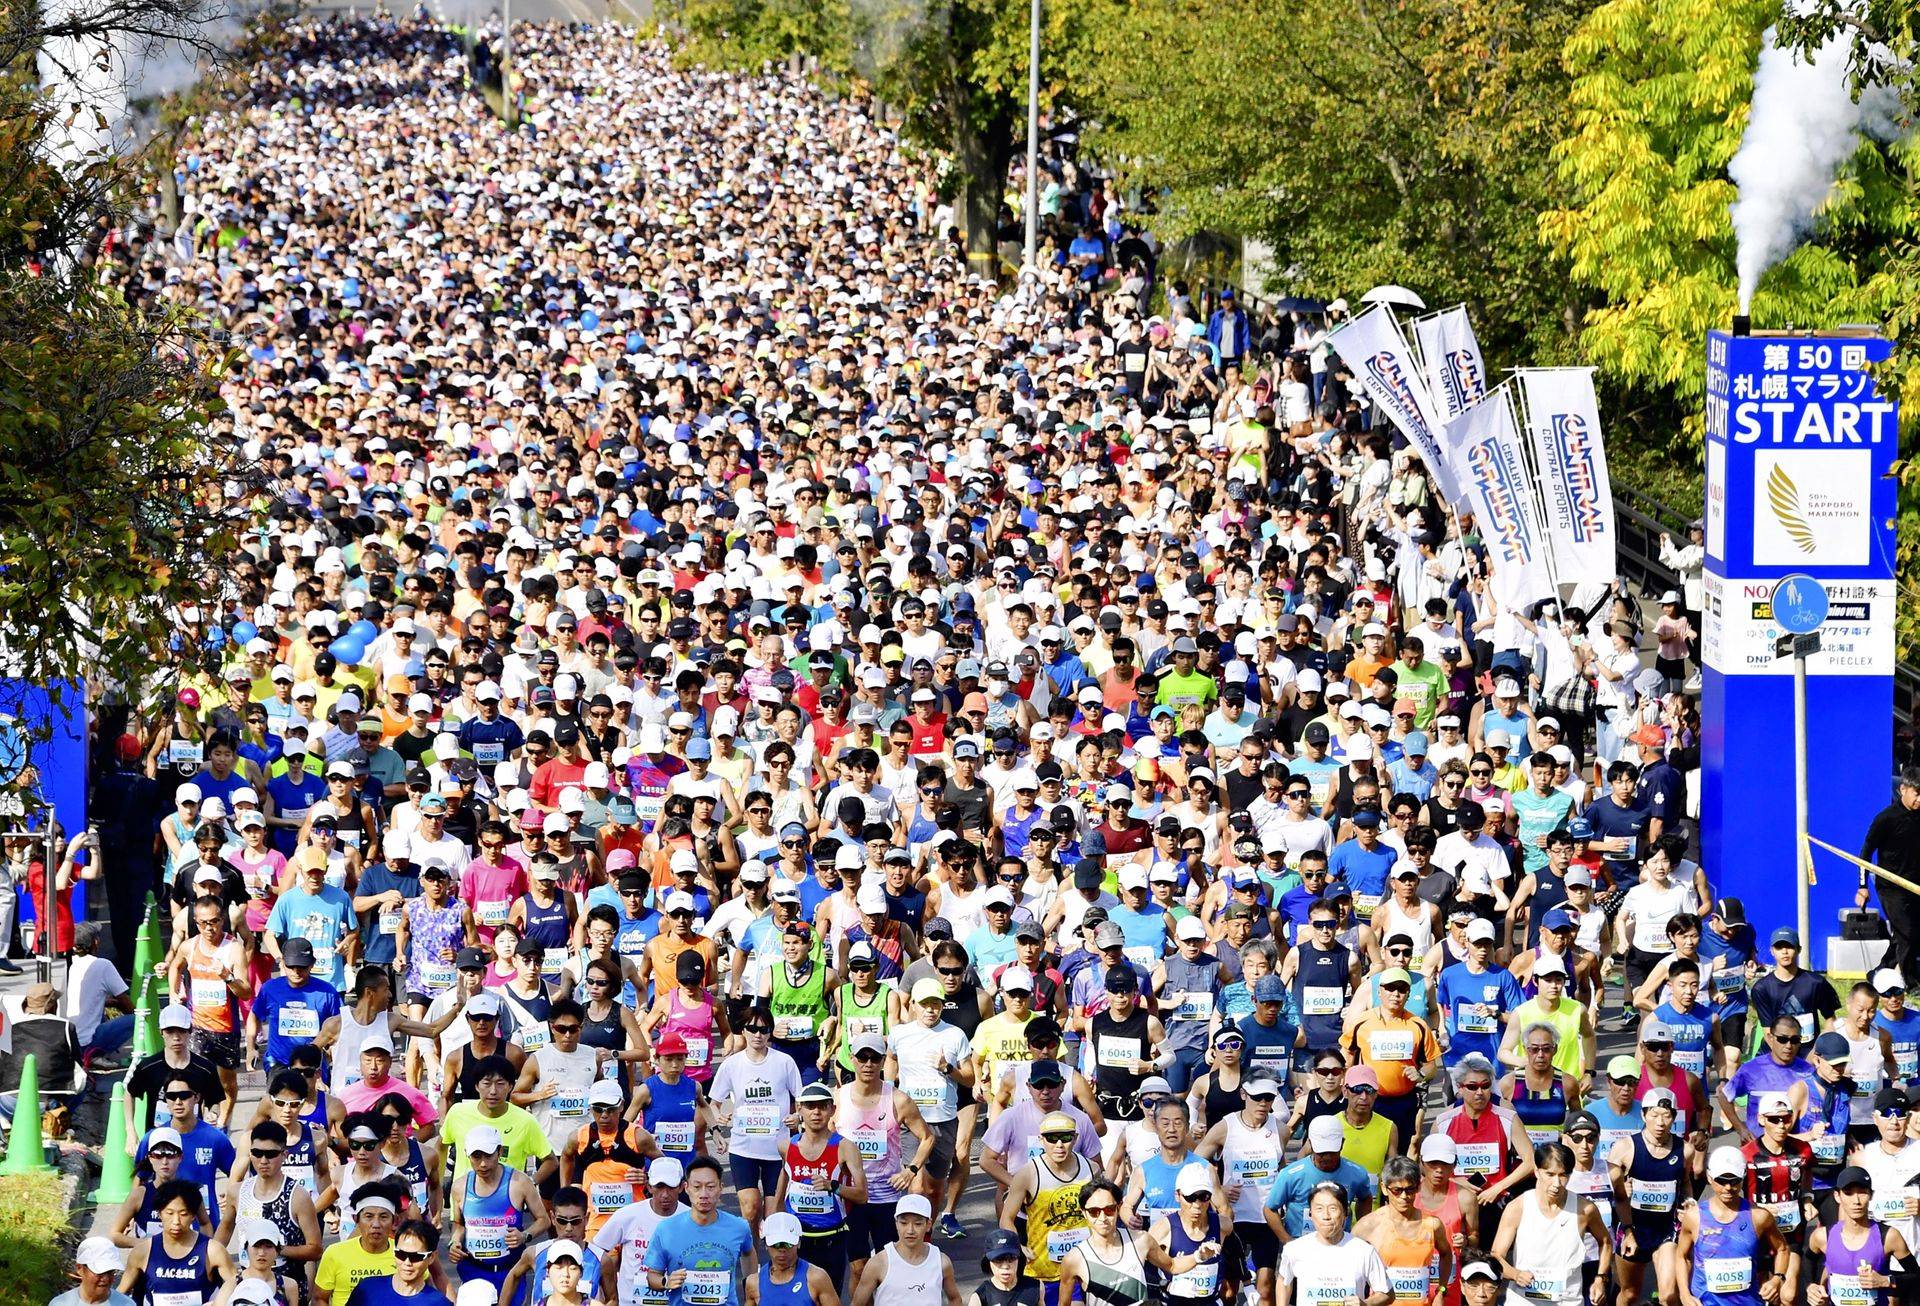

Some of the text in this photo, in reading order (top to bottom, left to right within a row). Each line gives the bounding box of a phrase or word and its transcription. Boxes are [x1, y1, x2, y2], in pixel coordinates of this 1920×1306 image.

[1366, 375, 1405, 416] CENTRAL
[1439, 367, 1458, 417] CENTRAL
[1706, 393, 1729, 440] START
[1734, 402, 1894, 443] START
[1542, 428, 1570, 529] CENTRAL SPORTS
[1746, 655, 1771, 664] DNP
[1829, 656, 1873, 666] PIECLEX
[478, 751, 499, 760] 6054
[485, 910, 507, 920] 6011
[1651, 933, 1669, 942] 800
[429, 973, 452, 982] 6023
[1719, 977, 1740, 986] 4073
[1313, 997, 1336, 1006] 6004
[1182, 1003, 1206, 1012] 6018
[289, 1020, 313, 1029] 2040
[1470, 1015, 1488, 1025] 127
[1001, 1039, 1027, 1051] RUN
[1380, 1041, 1406, 1051] 6049
[995, 1050, 1035, 1061] TOKYO
[1107, 1048, 1133, 1058] 6045
[914, 1087, 939, 1097] 4055
[551, 1098, 585, 1109] A 4002
[747, 1117, 772, 1127] 8502
[664, 1133, 689, 1143] 8501
[1243, 1159, 1270, 1170] 4006
[1464, 1155, 1491, 1166] 4059
[598, 1194, 626, 1205] 6006
[790, 1195, 825, 1206] A 4003
[1633, 1191, 1669, 1202] A 6009
[1884, 1200, 1905, 1210] 404
[1304, 1222, 1310, 1230] A
[475, 1239, 502, 1249] 4056
[635, 1240, 649, 1249] RU
[350, 1268, 384, 1276] OSAKA
[1716, 1271, 1744, 1282] 4058
[1394, 1278, 1423, 1290] 6008
[634, 1288, 640, 1296] A
[683, 1284, 721, 1295] A 2043
[1317, 1286, 1347, 1298] 4080
[1840, 1287, 1869, 1298] 2024
